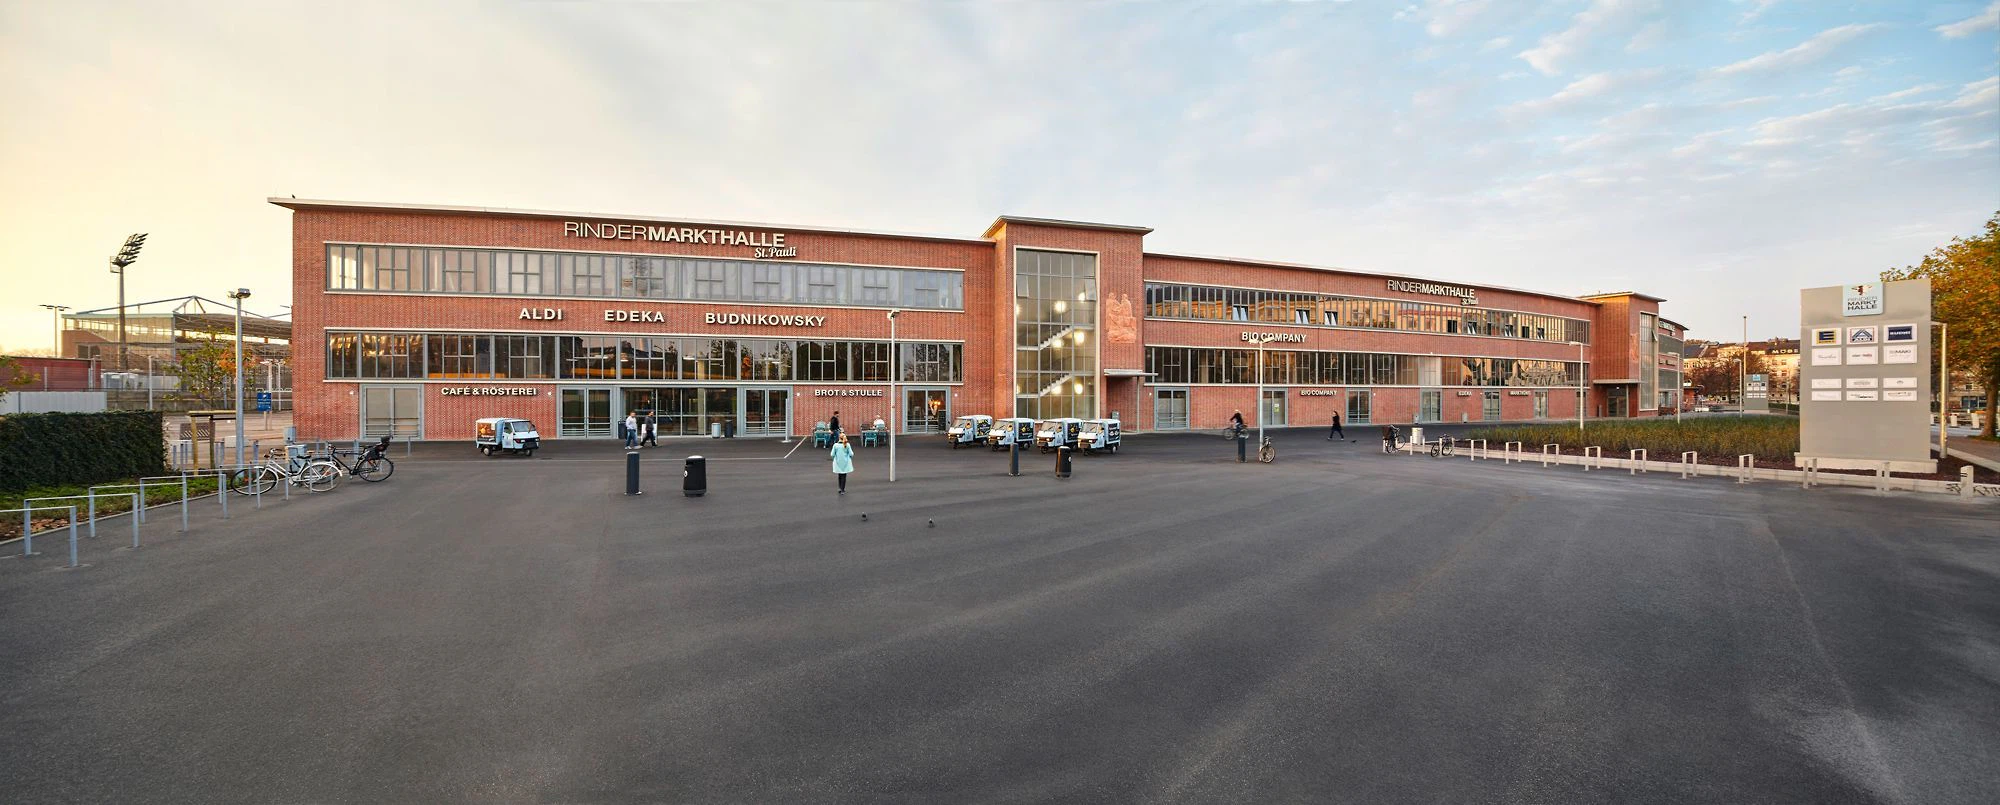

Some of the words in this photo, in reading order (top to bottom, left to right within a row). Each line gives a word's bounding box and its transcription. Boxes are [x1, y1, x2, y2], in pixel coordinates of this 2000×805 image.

[564, 221, 785, 247] RINDERMARKTHALLE
[519, 308, 563, 320] ALDI
[604, 309, 665, 323] EDEKA
[705, 312, 825, 327] BUDNIKOWSKY
[1242, 332, 1259, 341] BIO
[1261, 332, 1307, 342] COMPANY
[441, 386, 470, 395] CAFÉ
[472, 387, 480, 395] &
[482, 387, 537, 396] RÖSTEREI
